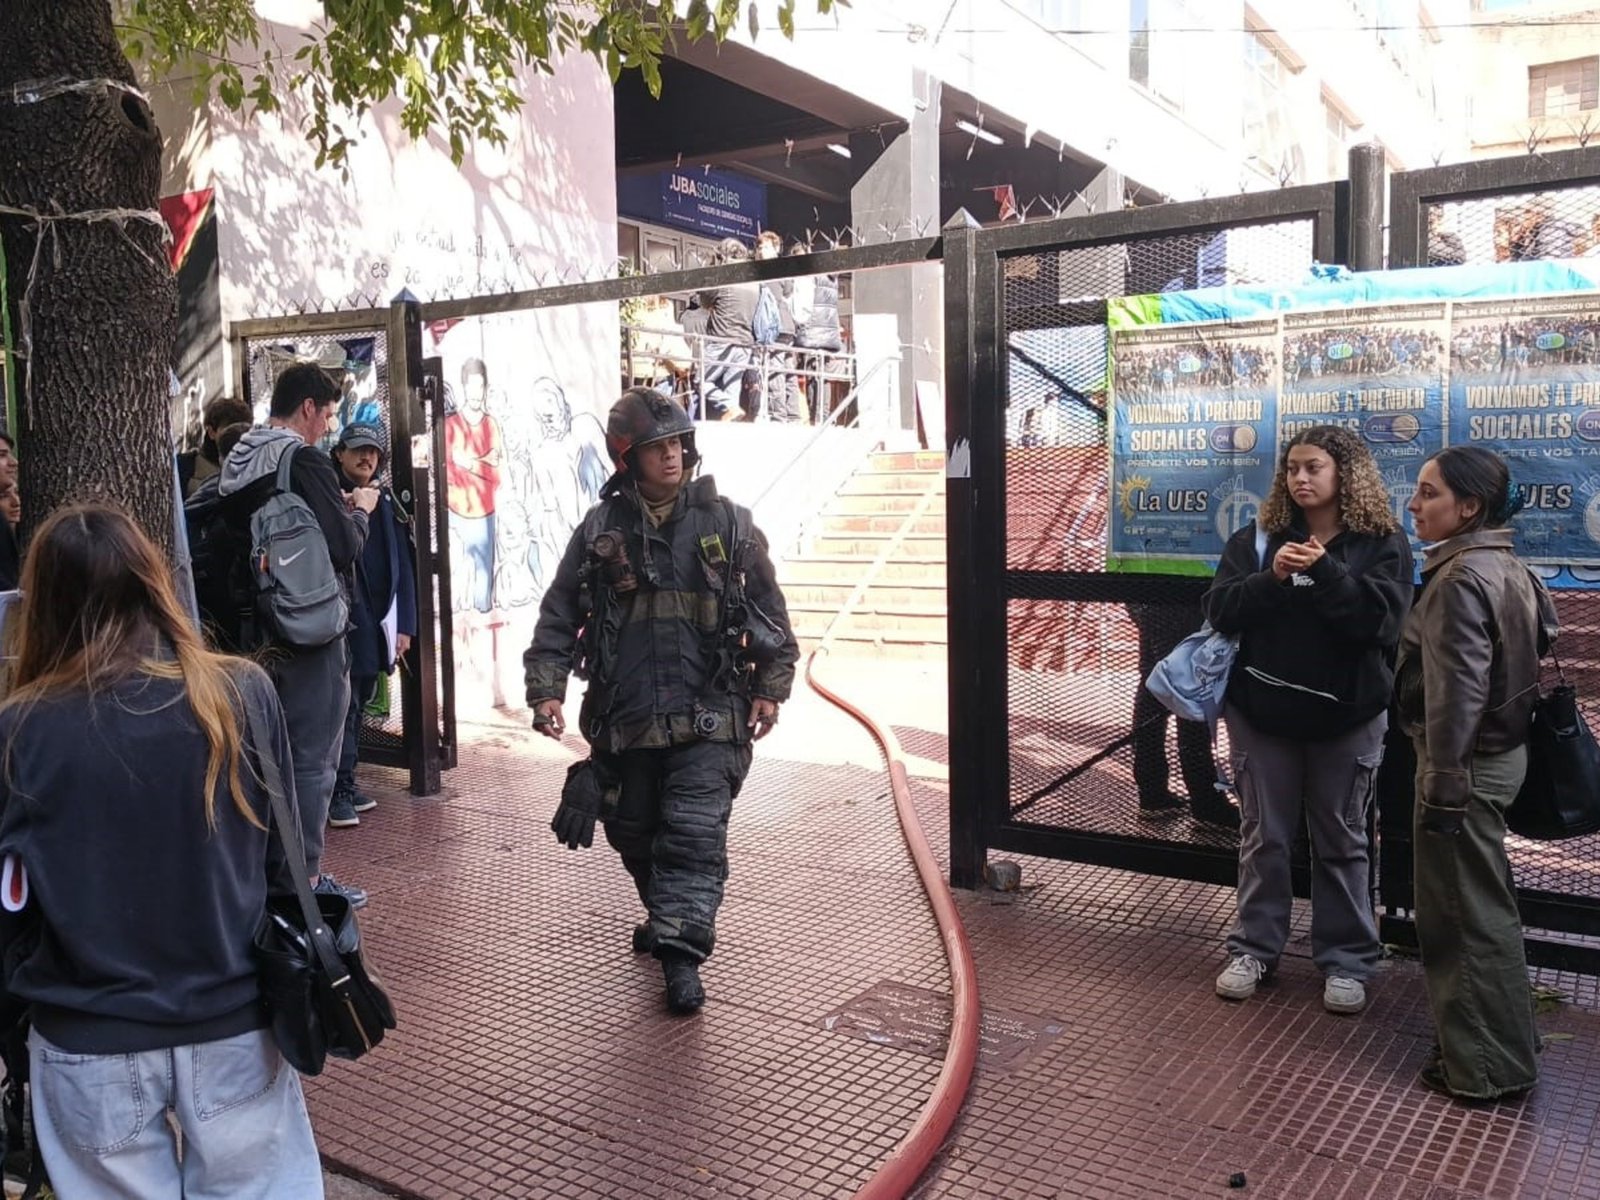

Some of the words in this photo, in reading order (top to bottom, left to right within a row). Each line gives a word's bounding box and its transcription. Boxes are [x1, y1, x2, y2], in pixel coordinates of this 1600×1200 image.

[371, 262, 390, 279] es
[1281, 390, 1340, 414] OLVAMOS
[1344, 391, 1354, 412] A
[1358, 387, 1425, 411] PRENDER
[1466, 383, 1550, 409] VOLVAMOS
[1554, 383, 1566, 406] A
[1128, 402, 1189, 424] VOLVAMOS
[1193, 402, 1202, 422] A
[1205, 400, 1262, 422] PRENDER
[1470, 413, 1573, 440] SOCIALES
[1131, 428, 1207, 451] SOCIALES
[1216, 434, 1229, 443] ON
[1127, 459, 1183, 468] PRENDETE
[1185, 458, 1208, 467] VOS
[1374, 446, 1425, 458] AMBIÉN
[1543, 448, 1573, 457] VOS
[1580, 447, 1600, 457] TA
[1138, 490, 1161, 512] La
[1167, 490, 1208, 512] UES
